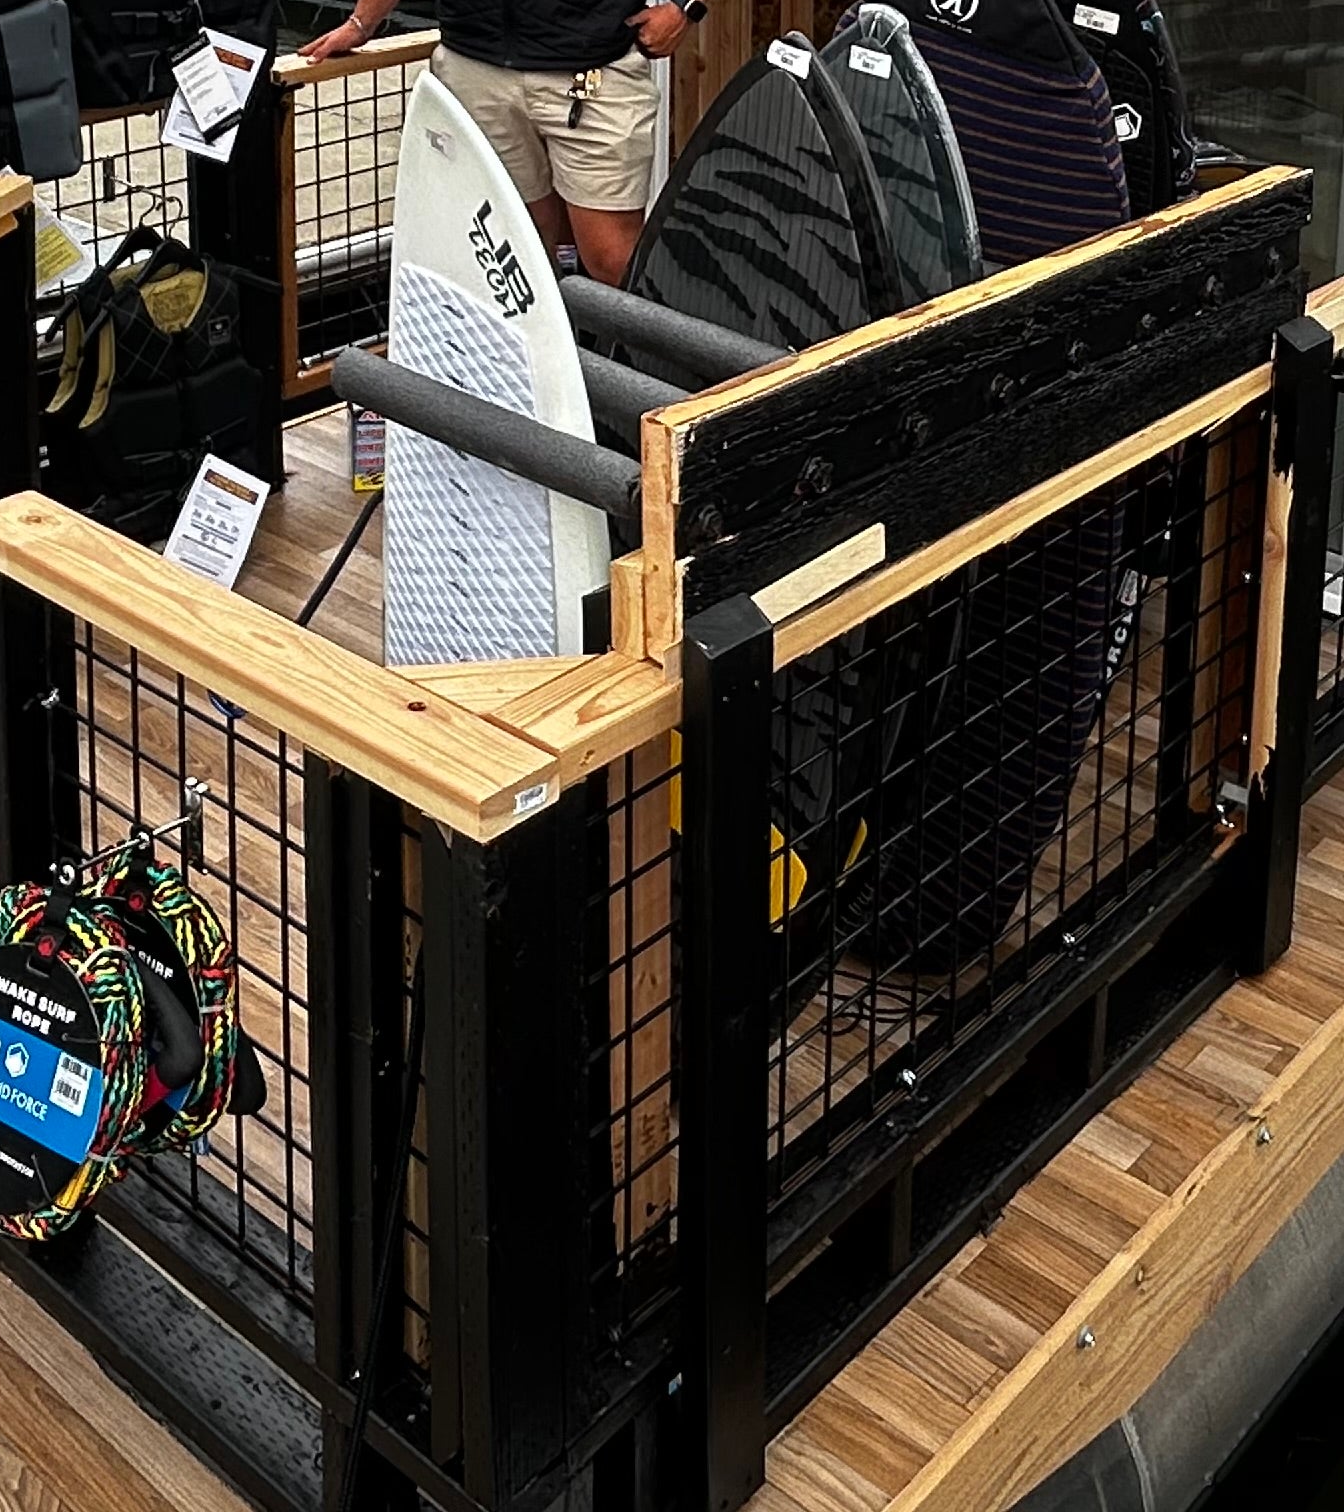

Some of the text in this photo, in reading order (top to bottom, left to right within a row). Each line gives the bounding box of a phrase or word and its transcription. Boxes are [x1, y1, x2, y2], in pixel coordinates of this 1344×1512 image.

[11, 1004, 52, 1036] ROPE
[37, 995, 77, 1024] SURF
[9, 1087, 49, 1122] FORCE
